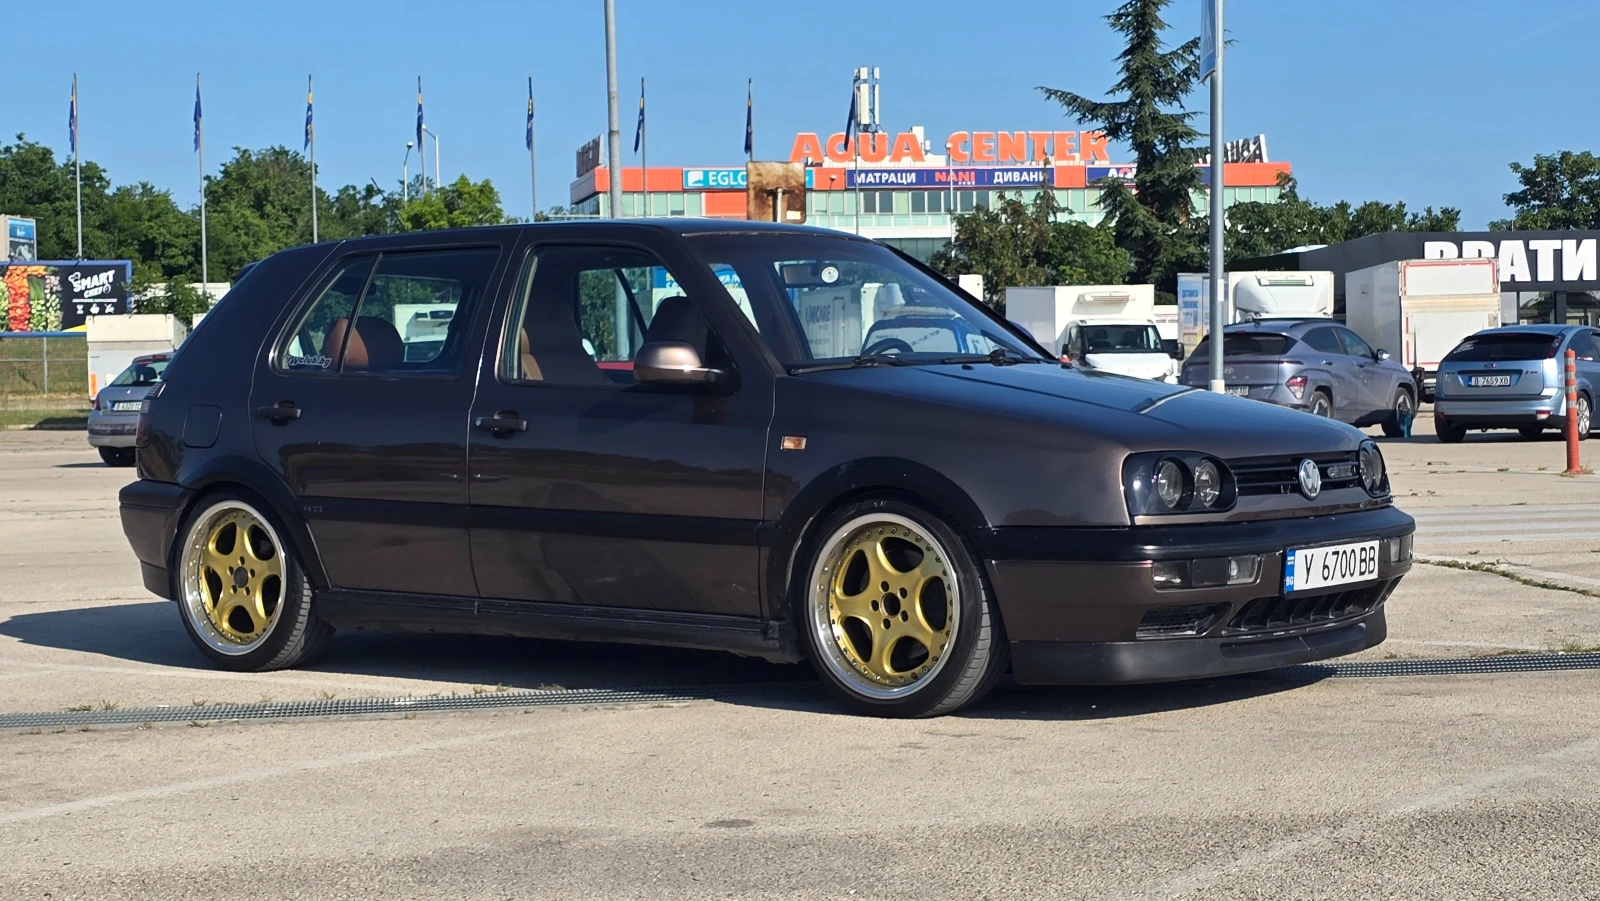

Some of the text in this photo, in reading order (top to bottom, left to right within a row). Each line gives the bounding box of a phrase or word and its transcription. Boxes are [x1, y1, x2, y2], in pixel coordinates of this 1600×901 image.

[789, 131, 1109, 163] AQUA CENTER
[854, 172, 916, 185] МАТРАЦИ
[934, 171, 976, 182] NANI
[73, 270, 115, 292] SMART
